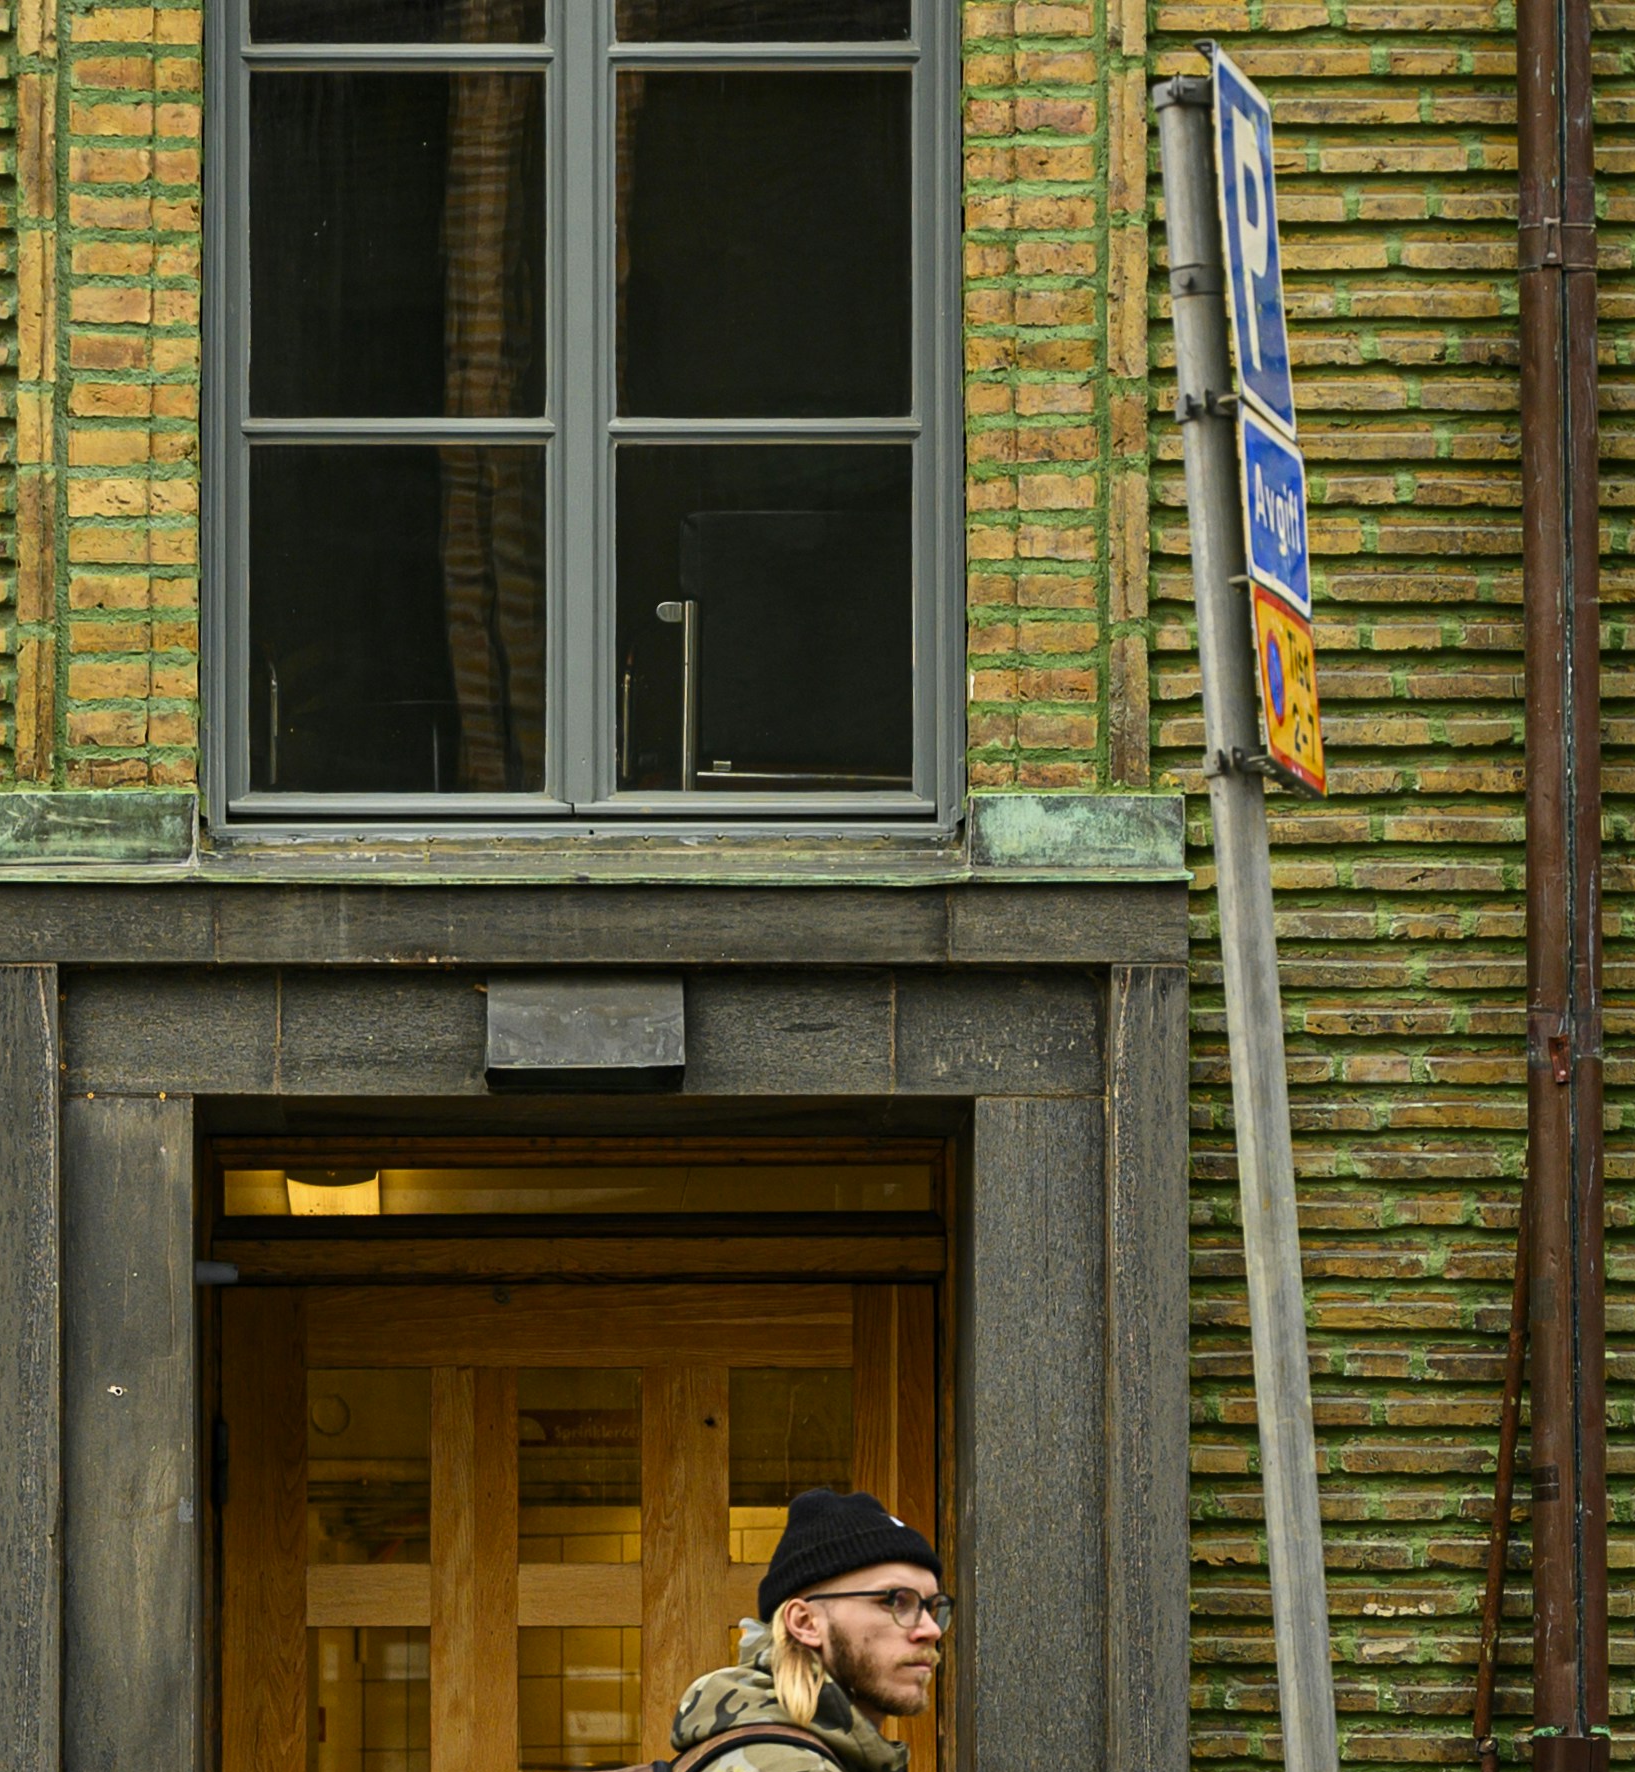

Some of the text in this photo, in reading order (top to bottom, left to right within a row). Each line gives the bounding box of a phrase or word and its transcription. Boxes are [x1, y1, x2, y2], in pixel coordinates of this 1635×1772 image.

[1232, 104, 1267, 372] P
[1254, 463, 1302, 557] Avgift
[1287, 629, 1311, 693] Tisd
[1292, 702, 1316, 764] 2-7
